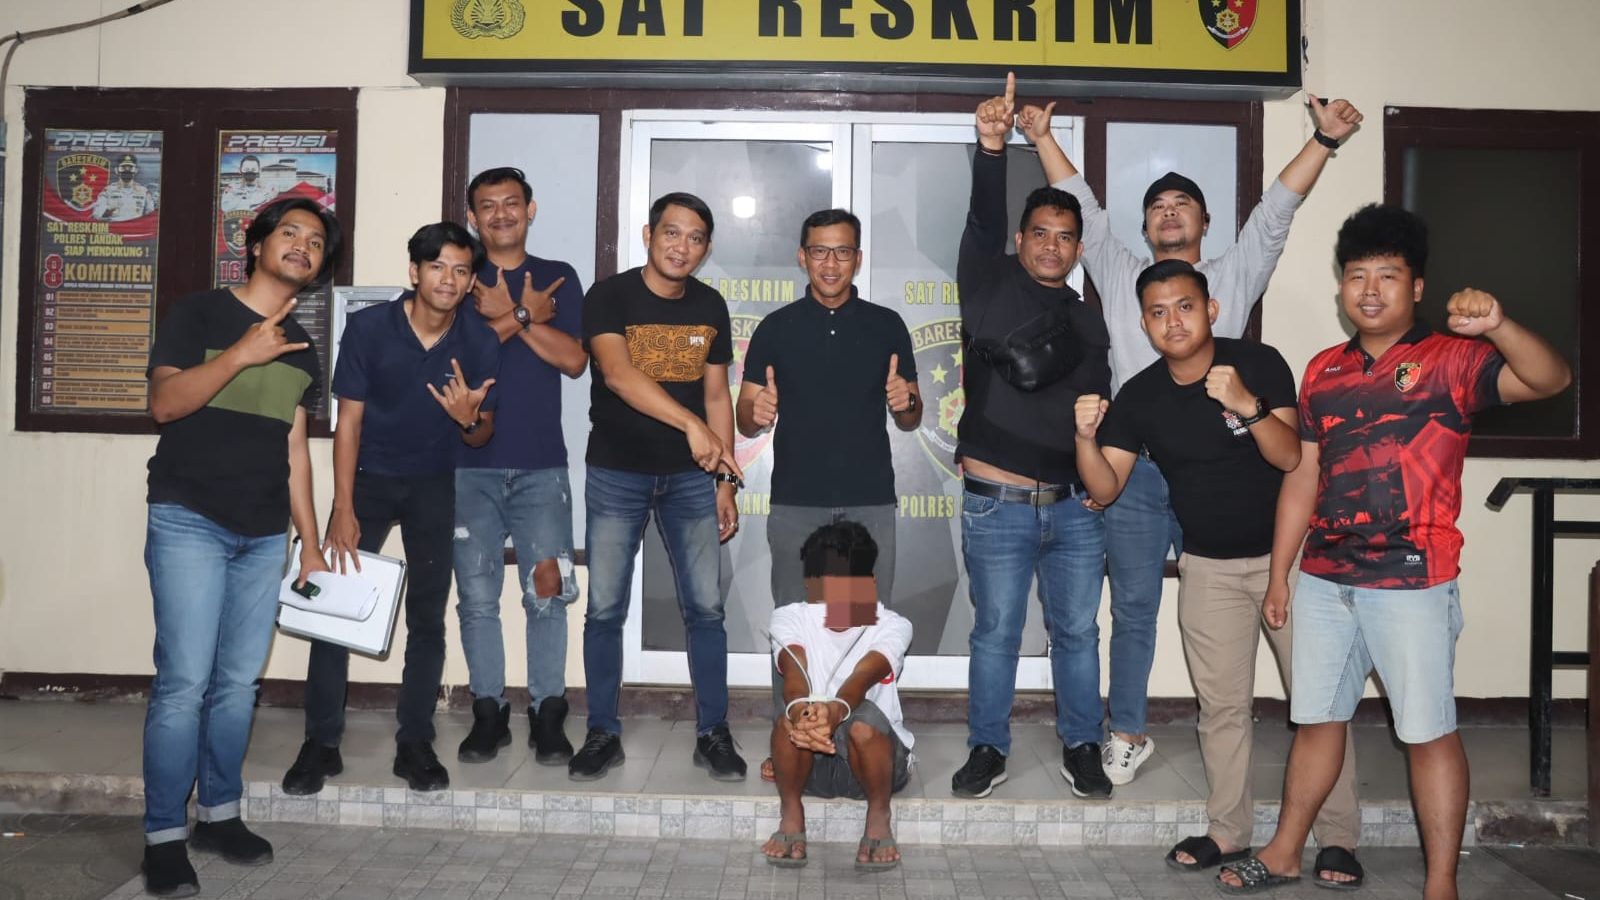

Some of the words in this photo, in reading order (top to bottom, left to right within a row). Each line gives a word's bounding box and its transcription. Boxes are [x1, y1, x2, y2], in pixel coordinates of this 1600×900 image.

[54, 132, 153, 147] PRESISI
[228, 135, 327, 147] PRESISI
[47, 222, 64, 233] SAT
[67, 222, 109, 234] RESKRIM
[54, 233, 86, 244] POLRES
[89, 234, 123, 245] LANDAK
[64, 245, 84, 256] SIAP
[86, 246, 143, 257] MENDUKUNG
[64, 263, 152, 282] KOMITMEN
[719, 279, 795, 302] RESKRIM
[905, 281, 935, 304] SAT
[900, 495, 954, 518] POLRES
